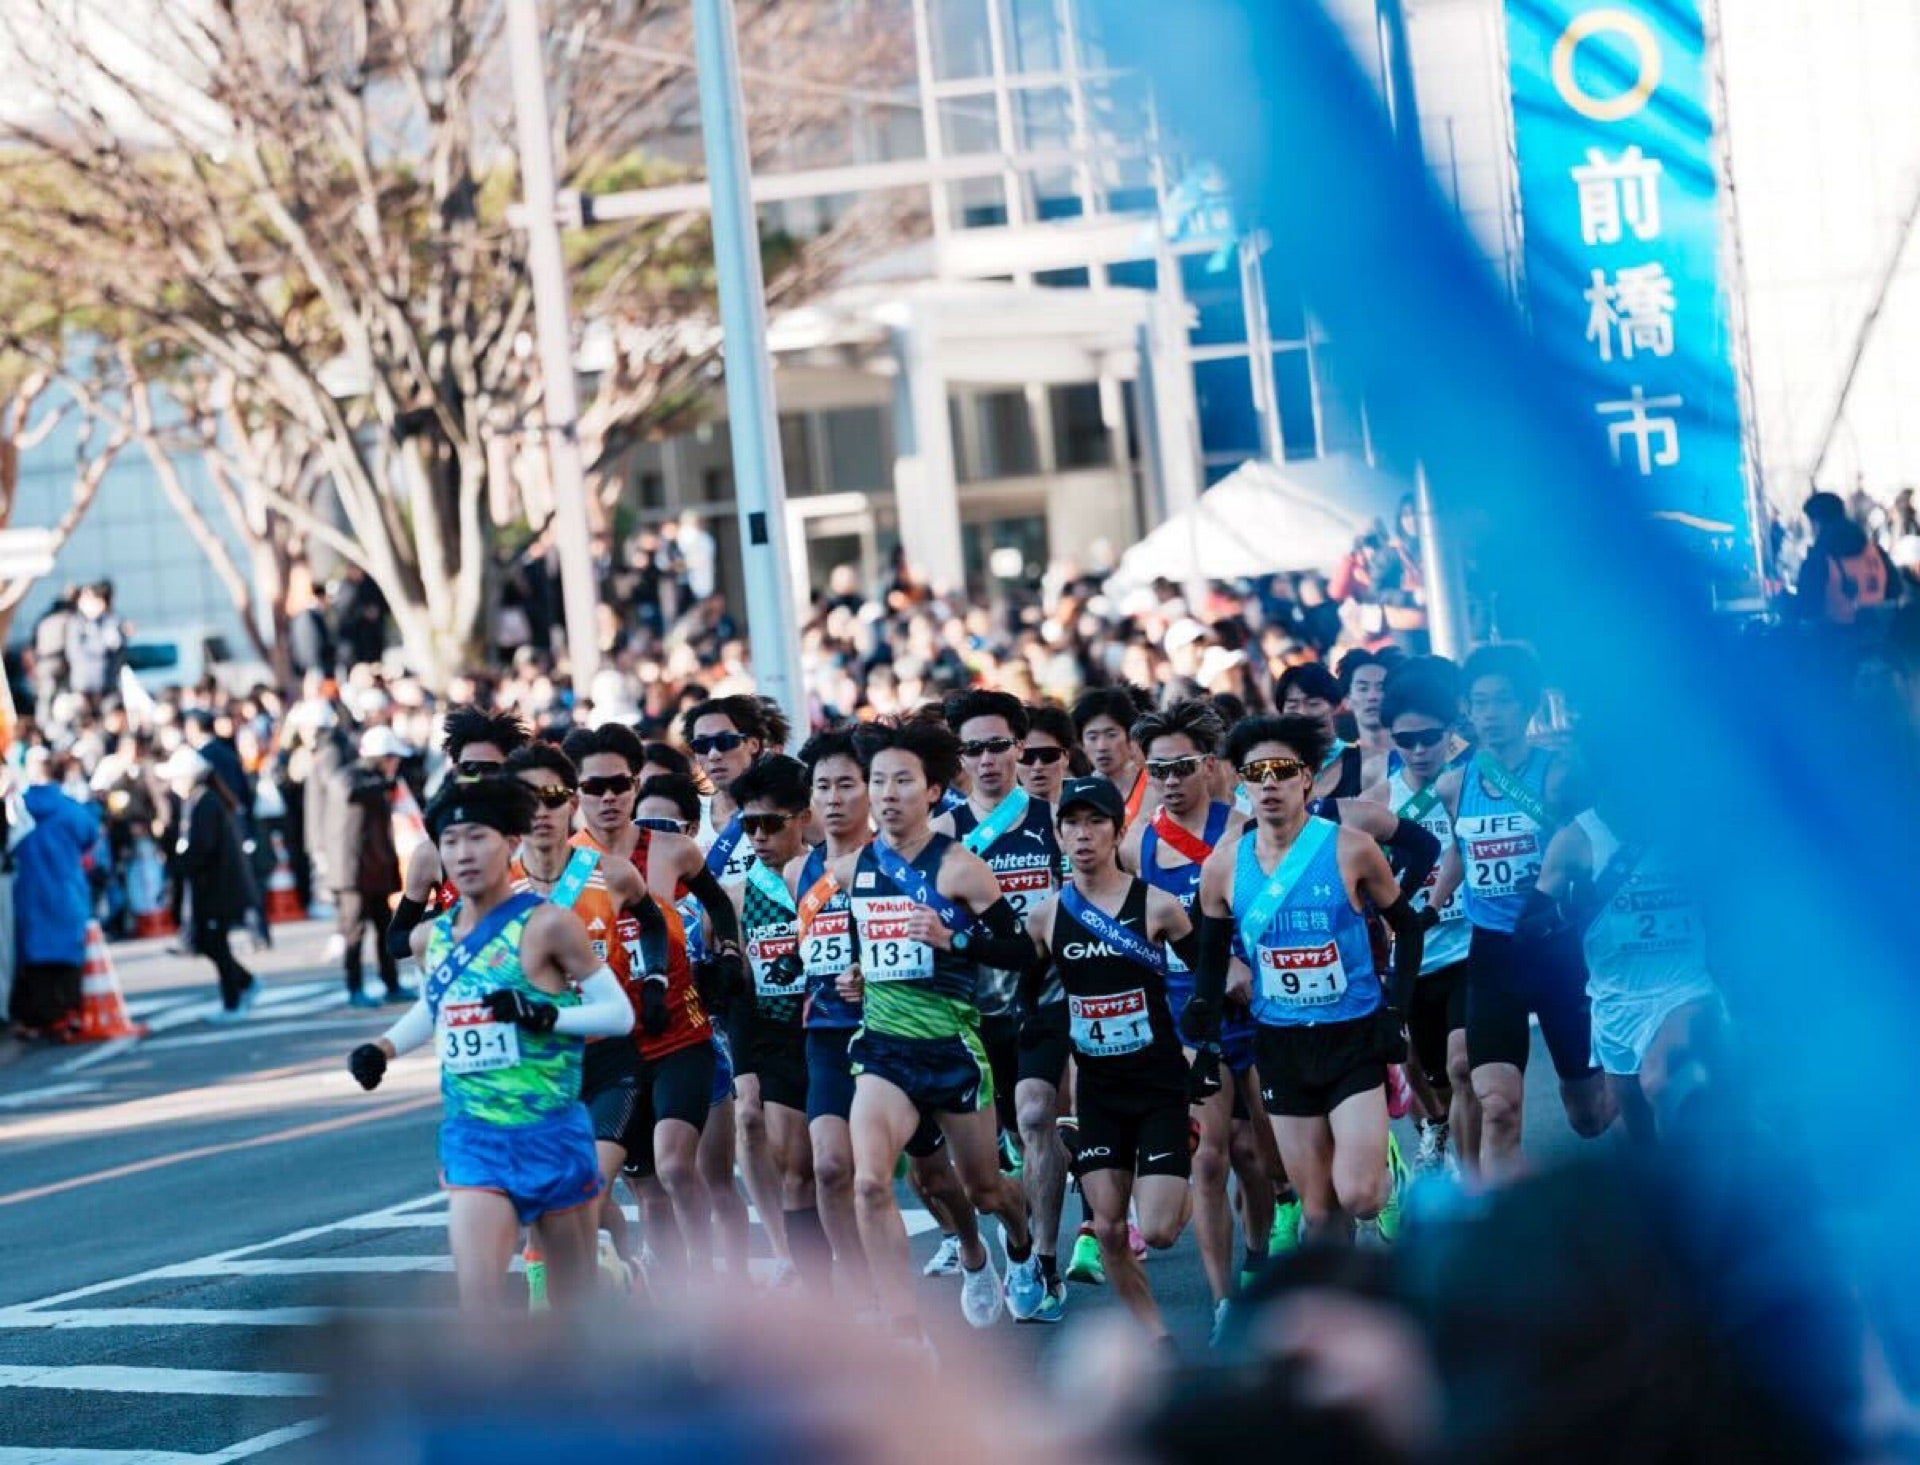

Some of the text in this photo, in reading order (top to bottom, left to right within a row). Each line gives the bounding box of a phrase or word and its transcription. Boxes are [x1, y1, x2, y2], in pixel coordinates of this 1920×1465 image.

[1572, 144, 1683, 476] 前橋市
[1472, 815, 1523, 835] JFE
[866, 901, 916, 912] Yakult
[870, 942, 922, 967] 13-1
[1281, 971, 1337, 995] 9-1
[446, 1029, 507, 1058] 39-1
[1089, 1020, 1140, 1044] 4-1
